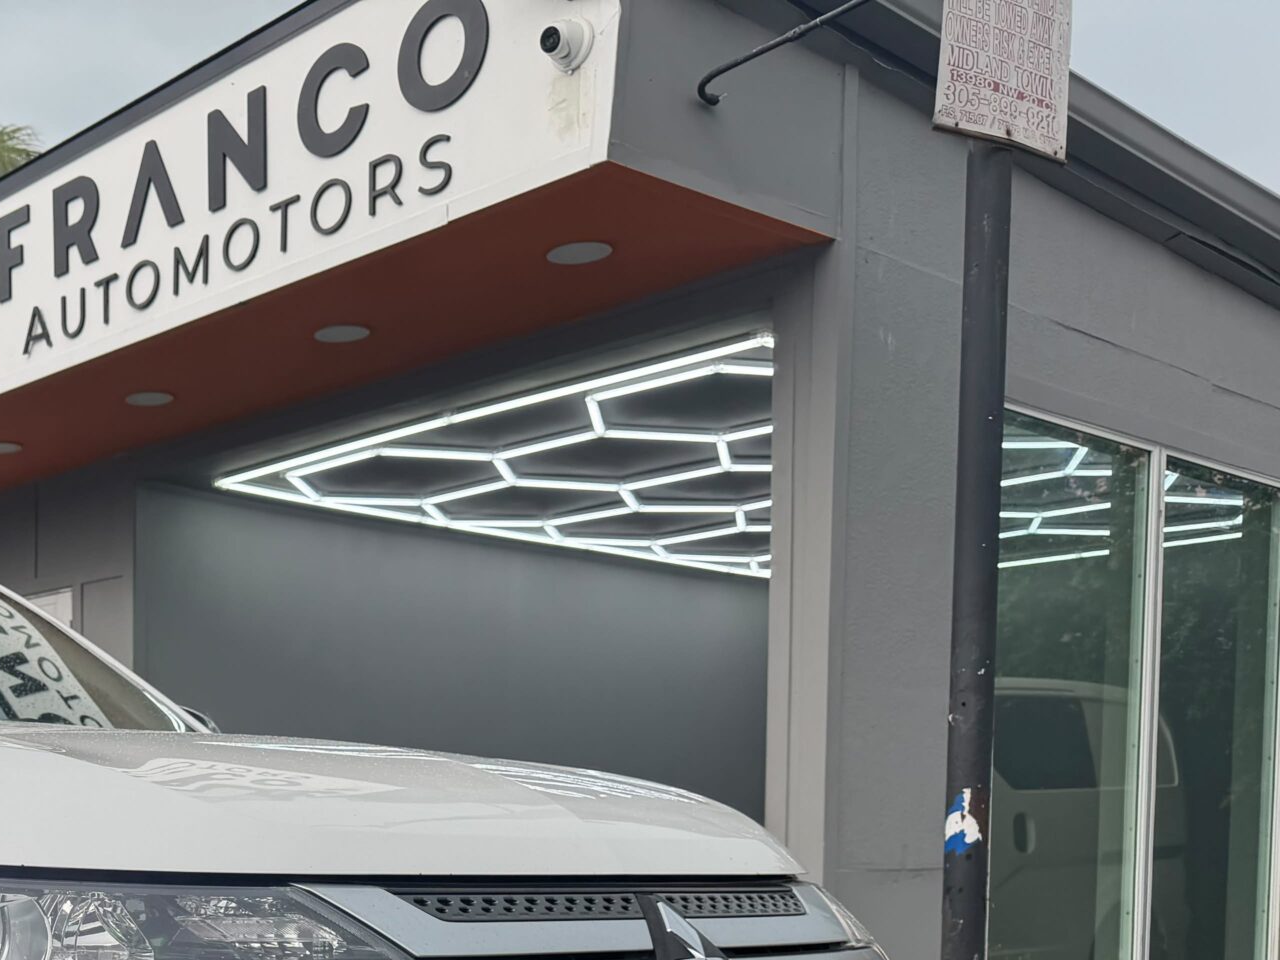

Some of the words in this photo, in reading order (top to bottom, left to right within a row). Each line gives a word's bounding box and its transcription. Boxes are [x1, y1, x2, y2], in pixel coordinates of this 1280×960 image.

[945, 11, 990, 52] OWNERS
[993, 26, 1017, 62] RISK
[993, 0, 1028, 35] TOWED
[1030, 11, 1055, 46] AWAY
[947, 44, 1010, 82] MIDLAND
[1014, 66, 1057, 101] TOWIN
[951, 69, 994, 90] 13980
[999, 84, 1018, 99] NW
[23, 134, 453, 356] AUTOMOTORS
